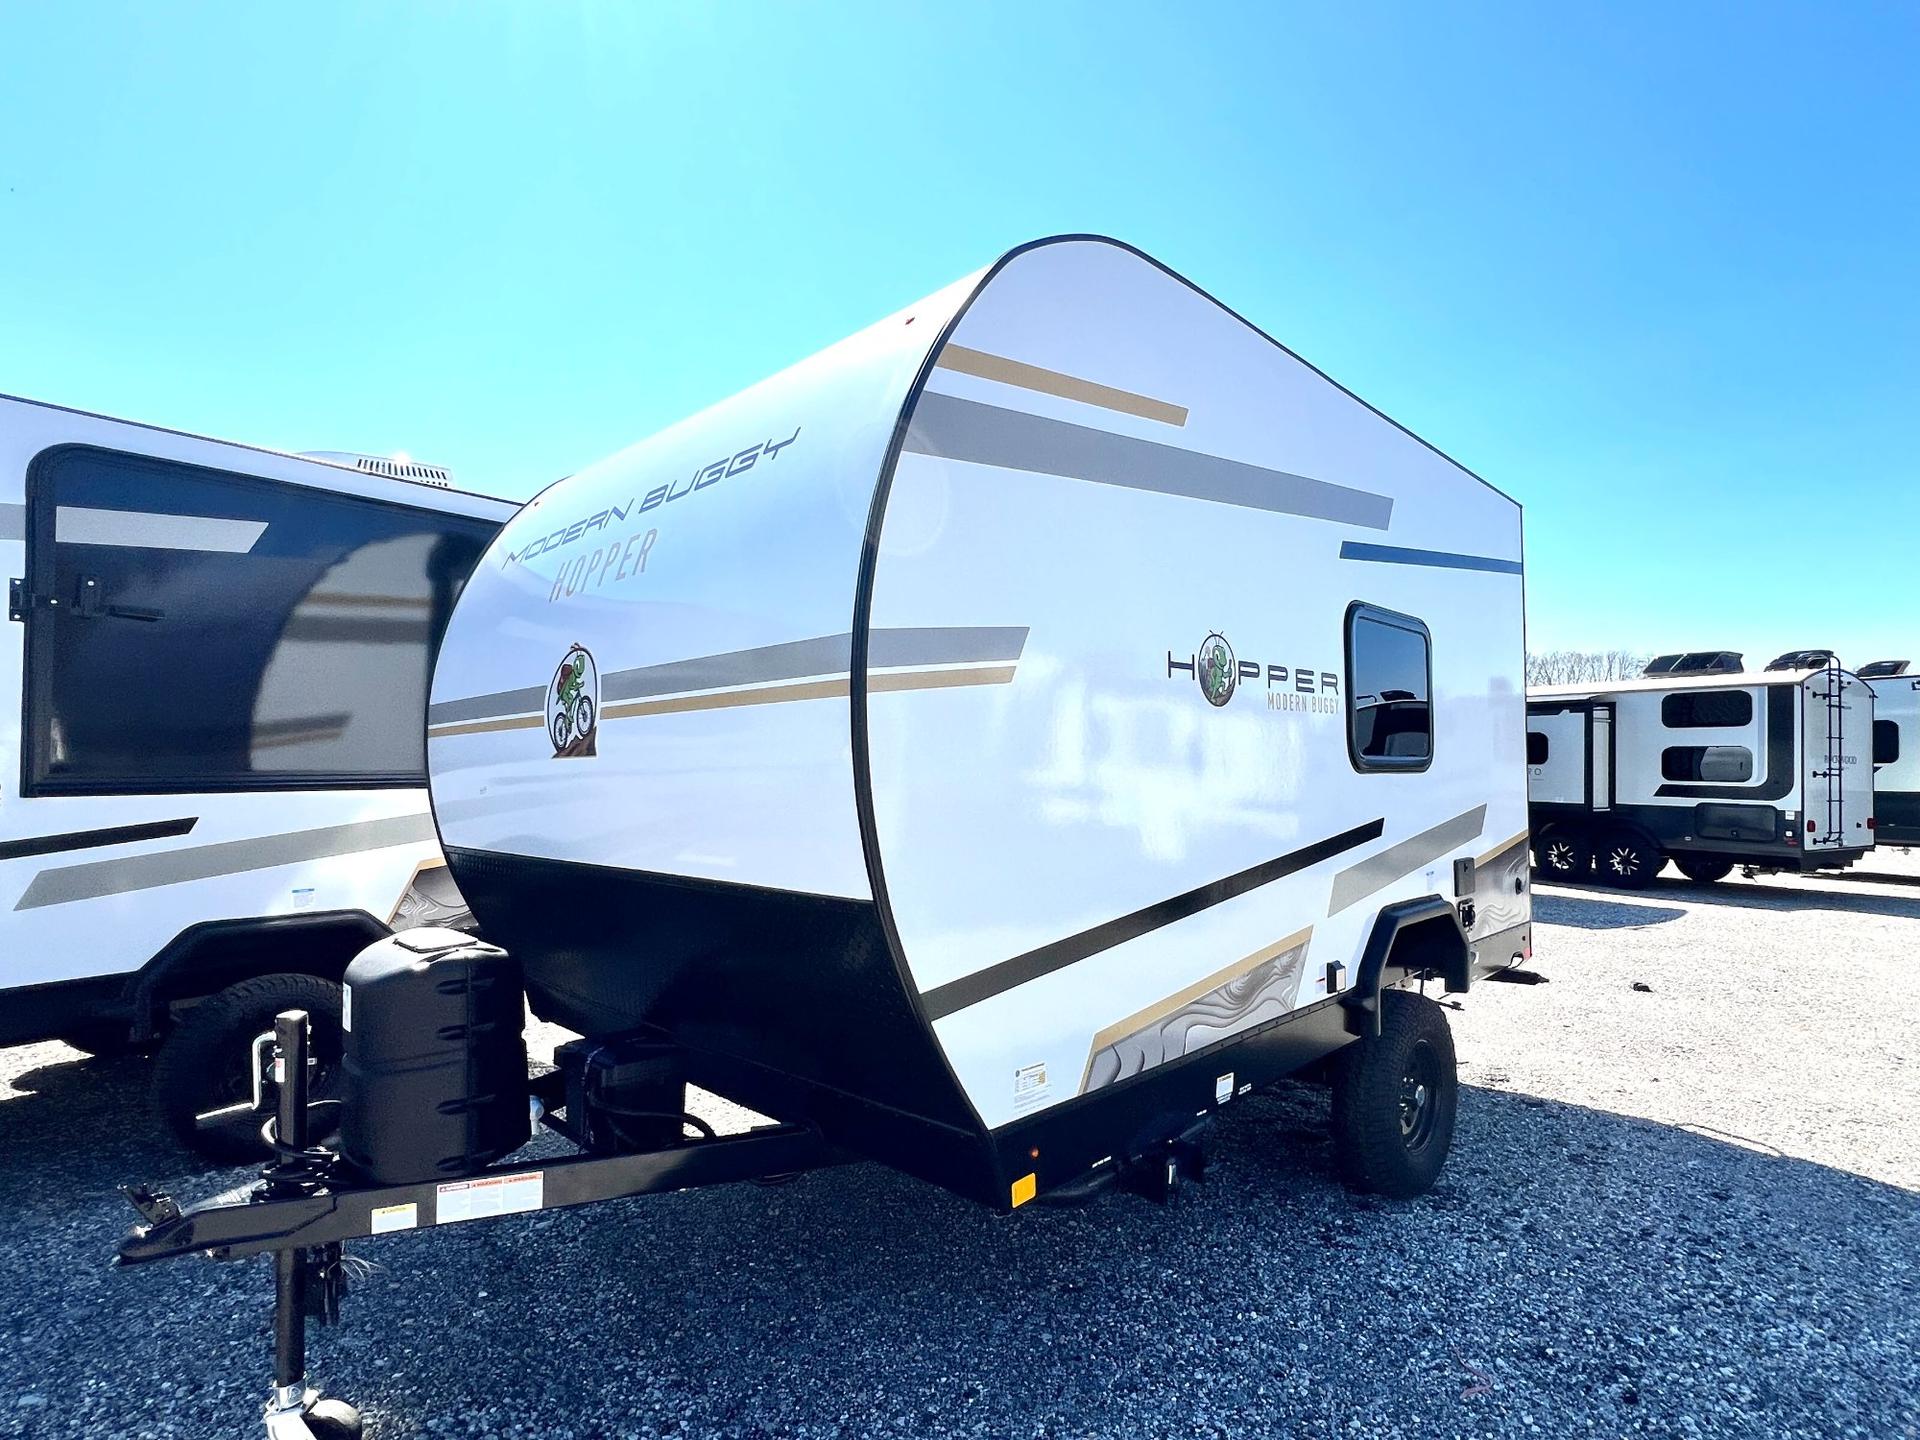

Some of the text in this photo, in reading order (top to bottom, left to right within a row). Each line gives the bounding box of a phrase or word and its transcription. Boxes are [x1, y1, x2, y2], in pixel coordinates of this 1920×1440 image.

[501, 427, 802, 571] MODERN BUGGY
[549, 528, 658, 603] HOPPER
[1267, 692, 1339, 715] MODERN BUGGY
